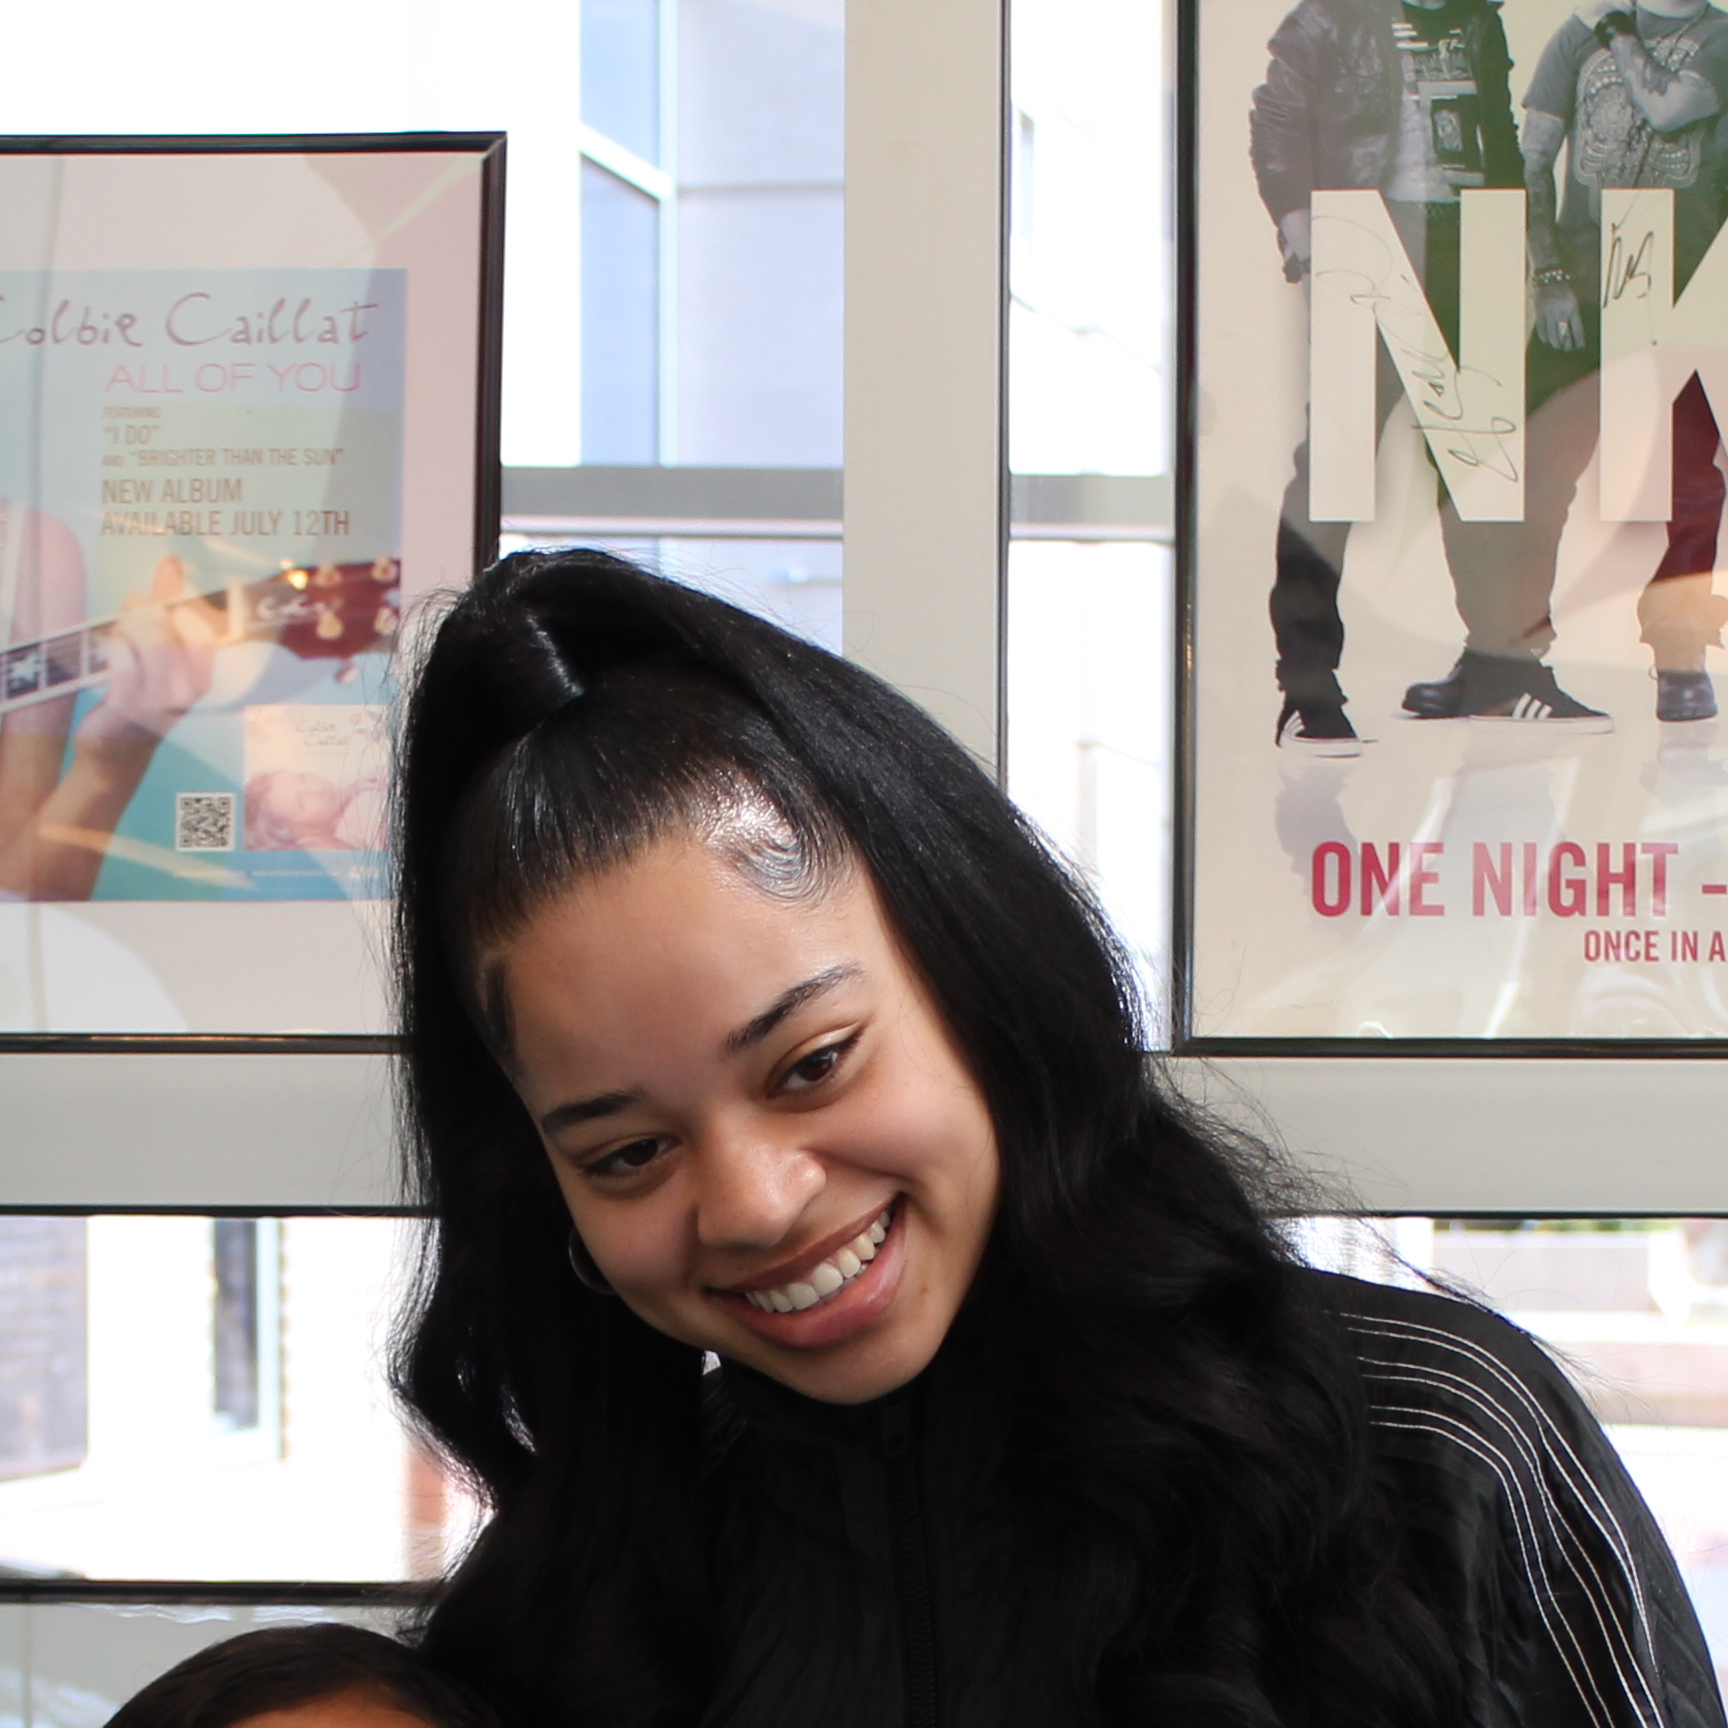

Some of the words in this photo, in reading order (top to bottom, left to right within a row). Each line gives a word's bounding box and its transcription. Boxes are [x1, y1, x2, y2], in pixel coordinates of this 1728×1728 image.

[165, 292, 380, 347] Caillat
[104, 363, 183, 393] ALL
[195, 363, 257, 393] OF
[267, 362, 362, 392] YOU
[223, 448, 263, 466] THAN
[268, 448, 298, 466] THE
[101, 479, 153, 504] NEW
[161, 478, 243, 503] ALBUM
[100, 510, 223, 537] AVAILABLE
[229, 510, 282, 536] JULY
[292, 510, 350, 536] 12TH
[1311, 841, 1445, 917] ONE
[1471, 841, 1680, 917] NIGHT
[1584, 929, 1660, 962] ONCE
[1671, 930, 1699, 962] IN
[1707, 930, 1726, 962] A
